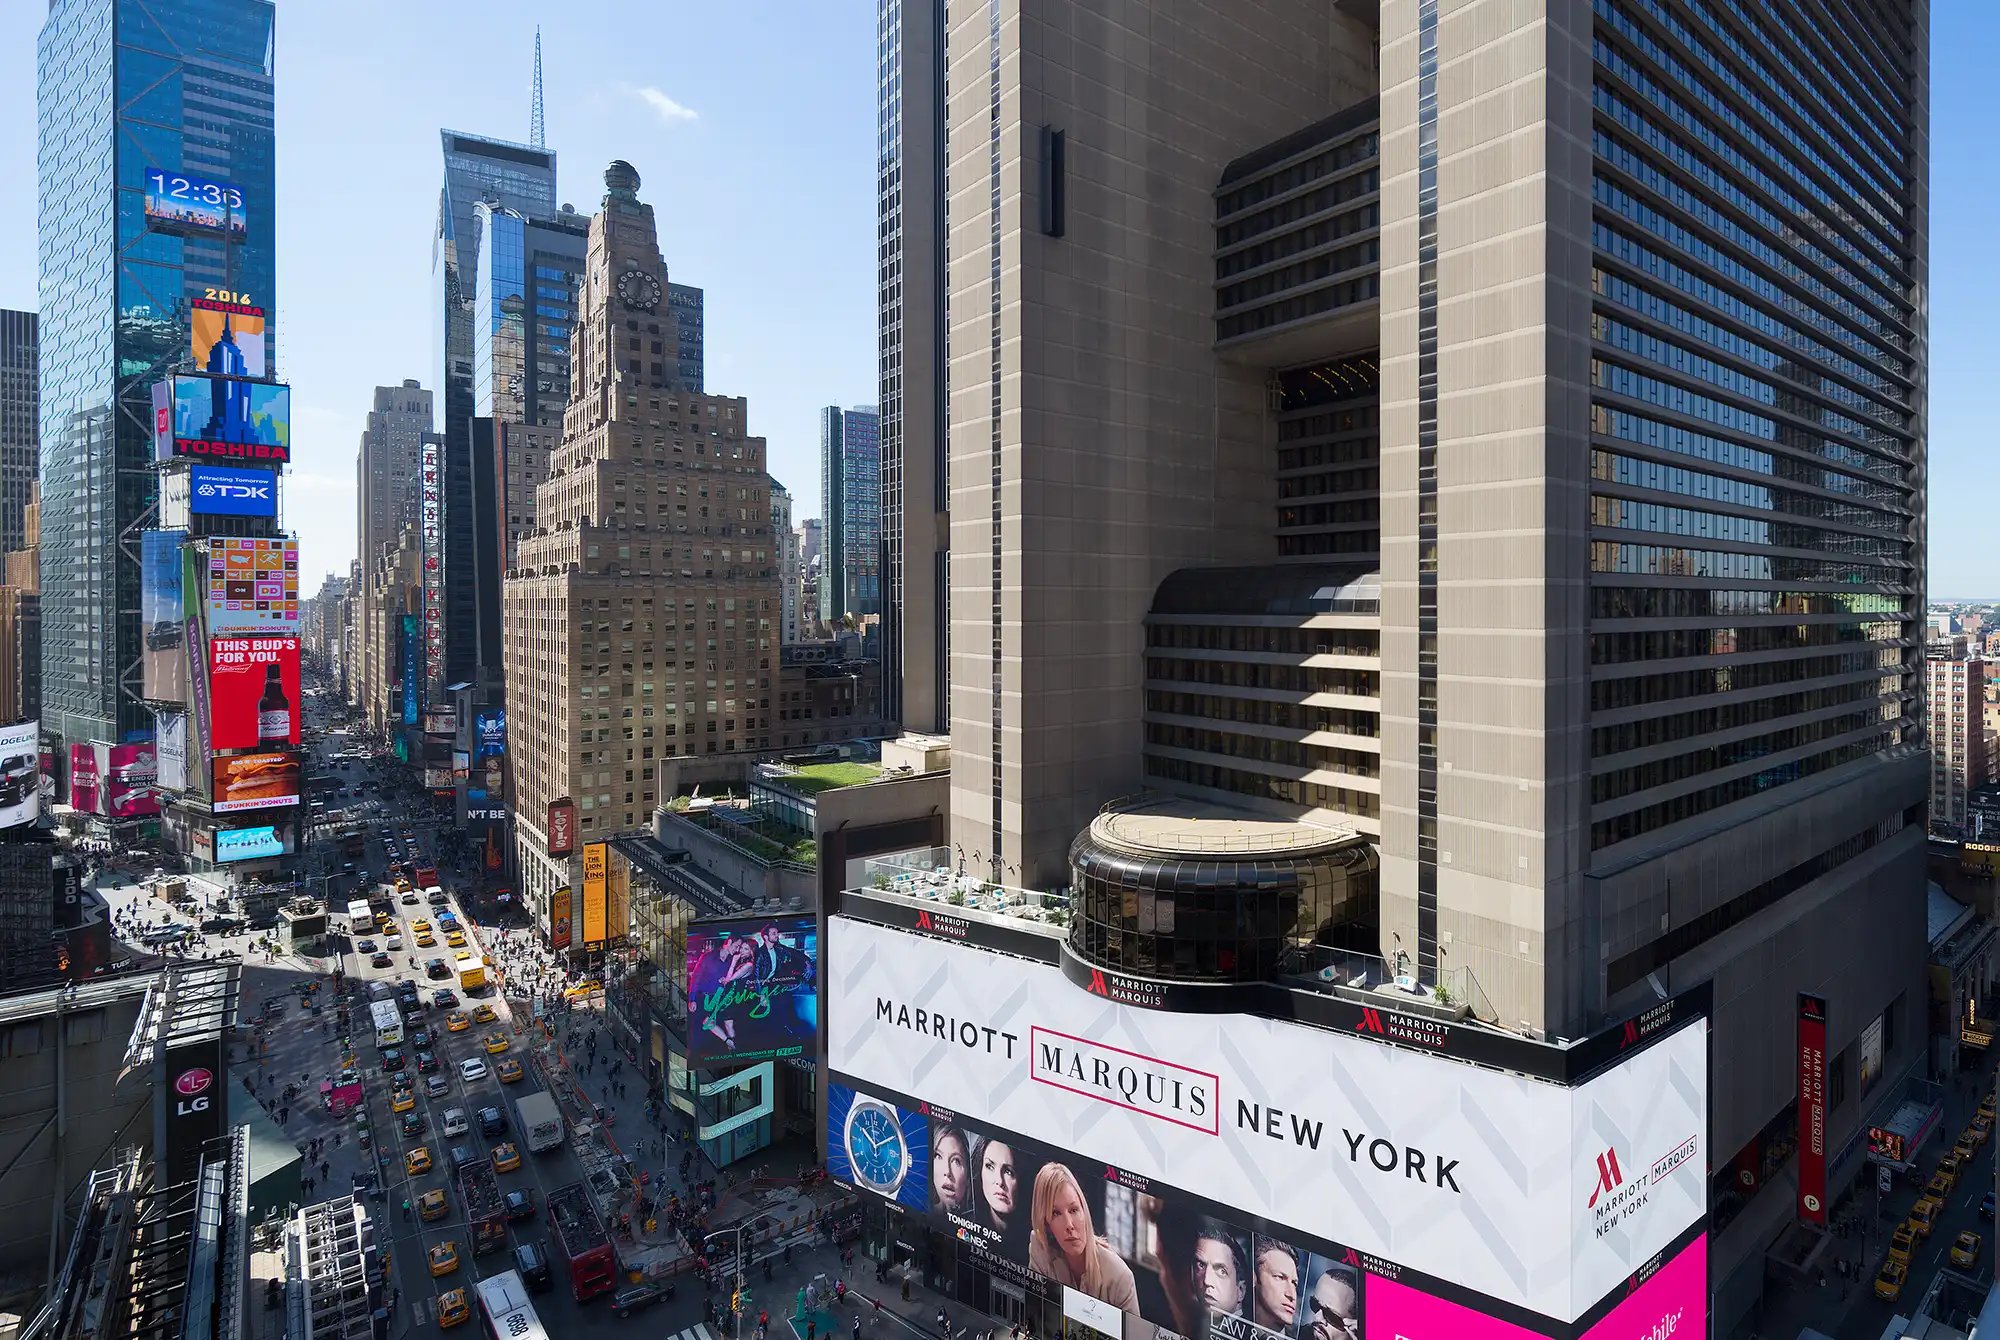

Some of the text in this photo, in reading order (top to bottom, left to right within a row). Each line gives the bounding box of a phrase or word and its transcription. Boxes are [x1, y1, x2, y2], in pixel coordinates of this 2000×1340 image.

[152, 174, 242, 209] 12:36
[205, 288, 251, 305] 2016
[192, 299, 263, 316] TOSHIBA
[175, 439, 288, 460] TOSHIBA
[198, 475, 233, 483] Attracting
[214, 485, 269, 499] TDK
[215, 639, 296, 652] THIS BUD'S
[215, 651, 281, 663] FOR YOU.
[584, 871, 605, 881] KING
[585, 863, 602, 871] LION
[64, 868, 77, 904] 1500
[934, 915, 970, 929] MARRIOTT
[934, 923, 966, 937] MARQUIS
[1112, 976, 1169, 995] MARRIOTT
[1112, 987, 1162, 1006] MARQUIS
[1640, 1000, 1675, 1024] MARRIOTT
[1389, 1013, 1451, 1036] MARRIOTT
[1640, 1013, 1671, 1035] MARQUIS
[1389, 1024, 1443, 1046] MARQUIS
[876, 997, 1463, 1194] MARRIOTT MARQUIS NEW YORK
[1803, 1074, 1811, 1100] YORK
[177, 1096, 209, 1116] LG
[931, 1104, 955, 1119] MARRIOTT
[1813, 1050, 1822, 1154] MARRIOTT MARQUIS
[931, 1110, 952, 1123] MARQUIS
[1120, 1169, 1150, 1186] MARRIOTT
[1120, 1176, 1147, 1191] MARQUIS
[1596, 1141, 1695, 1221] MARRIOTT MARQUIS
[1596, 1192, 1649, 1239] NEW YORK
[947, 1212, 1002, 1243] TONIGHT 9/8c
[970, 1234, 988, 1249] NBC
[969, 1255, 998, 1273] OPENING
[999, 1267, 1030, 1287] OCTOBER
[1363, 1254, 1402, 1273] MARRIOTT
[1363, 1262, 1398, 1280] MARQUIS
[1640, 1252, 1663, 1275] MARRIOTT
[1209, 1311, 1246, 1339] LAW
